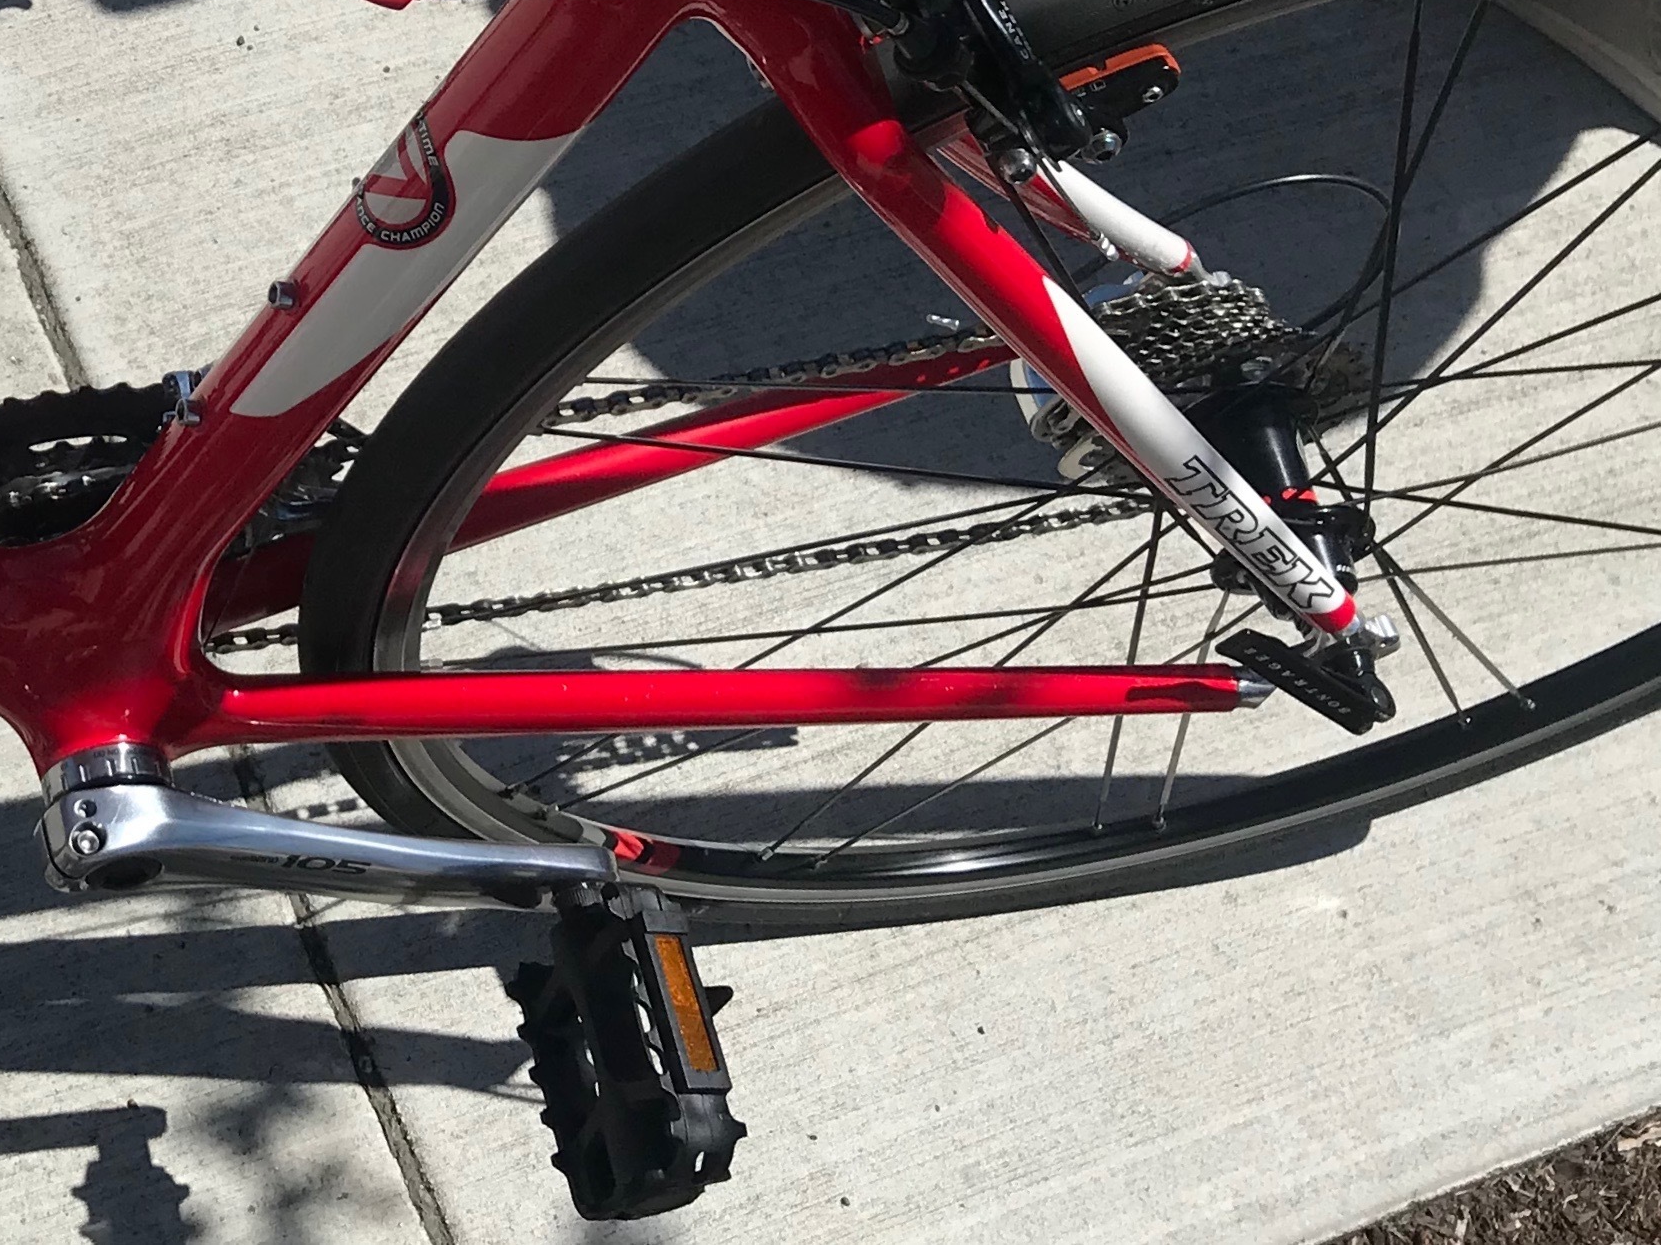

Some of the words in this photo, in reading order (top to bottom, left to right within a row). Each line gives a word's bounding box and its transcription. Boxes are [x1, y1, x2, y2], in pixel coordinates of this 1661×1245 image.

[380, 201, 444, 241] CHAMPION
[1165, 455, 1335, 610] TREK
[281, 854, 372, 875] 105
